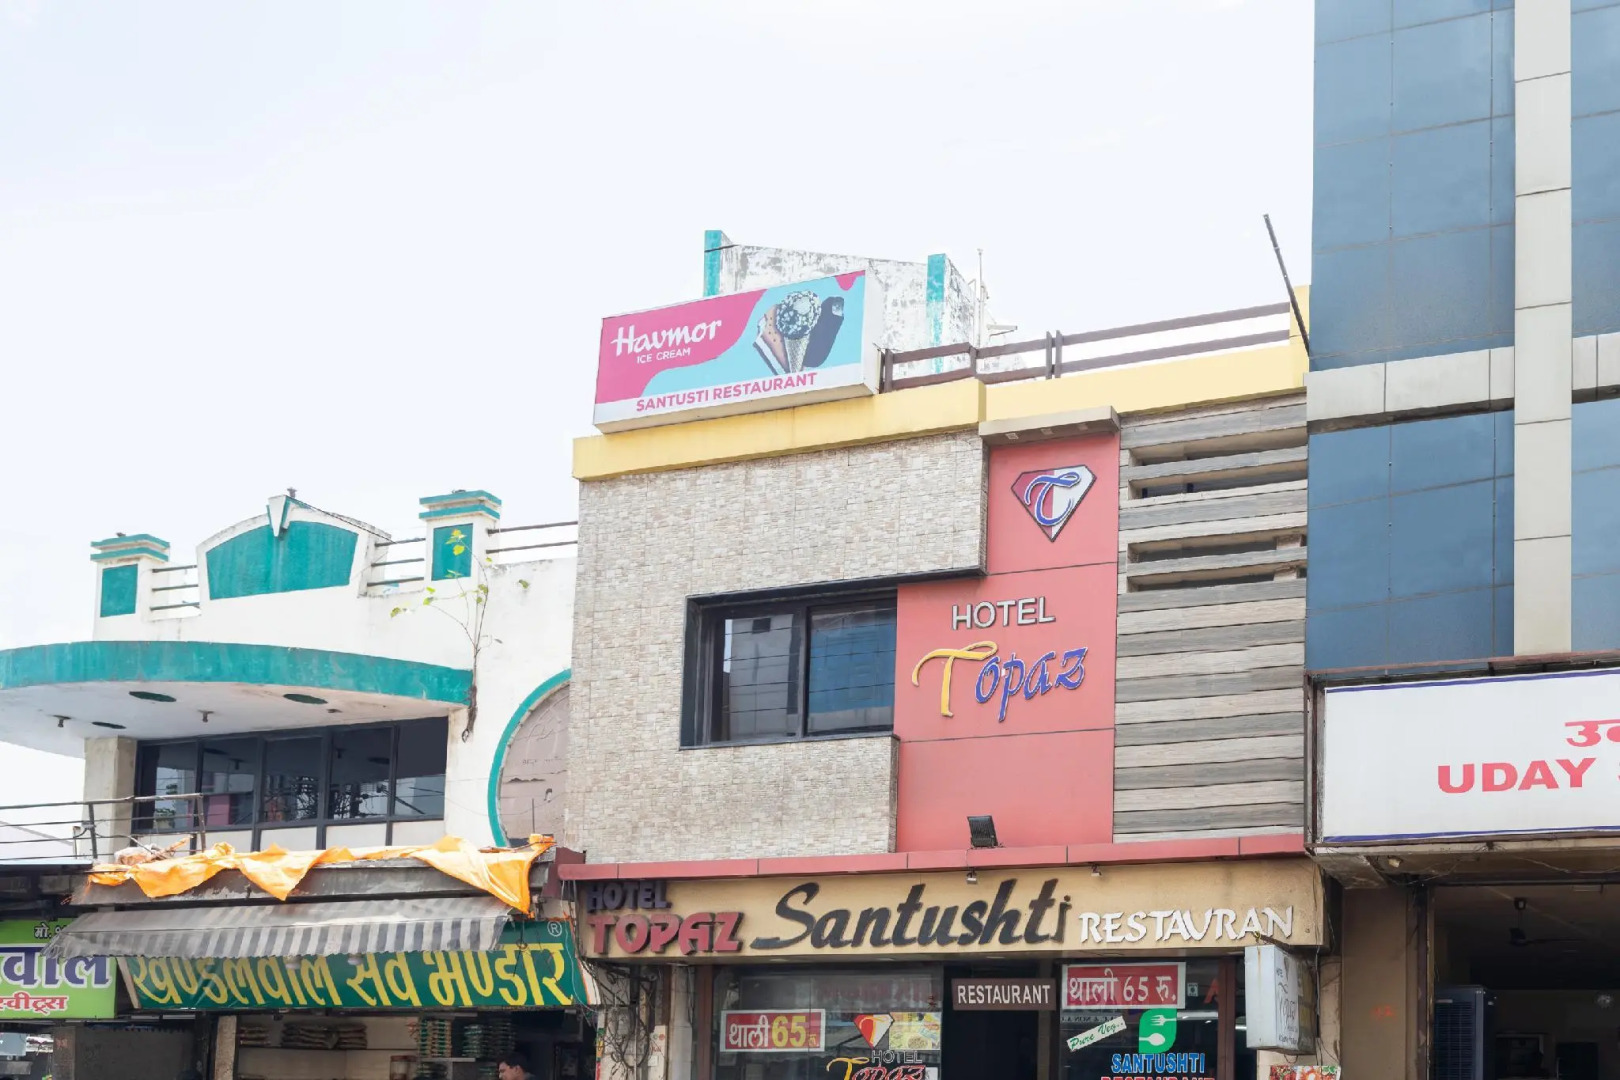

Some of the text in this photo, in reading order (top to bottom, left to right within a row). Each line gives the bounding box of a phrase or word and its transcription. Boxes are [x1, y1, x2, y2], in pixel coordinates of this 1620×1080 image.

[610, 318, 722, 357] Havmor
[637, 347, 691, 364] ICE CREAM
[636, 372, 819, 412] SANTUSTI RESTAURANT
[951, 596, 1056, 631] HOTEL
[911, 640, 1088, 723] Topaz
[1437, 757, 1597, 794] UDAY
[586, 880, 673, 911] HOTEL
[749, 877, 1072, 949] Santushti
[587, 911, 744, 954] TOPAZ
[0, 946, 110, 986] वाल
[957, 984, 1051, 1005] RESTAURANT
[1069, 967, 1119, 1002] थाली
[1123, 976, 1149, 1002] 65
[728, 1014, 771, 1048] थाली
[771, 1015, 808, 1047] 65
[1069, 1031, 1096, 1050] Pure
[871, 1050, 923, 1064] HOTEL
[1110, 1052, 1206, 1074] SANTUSHTI
